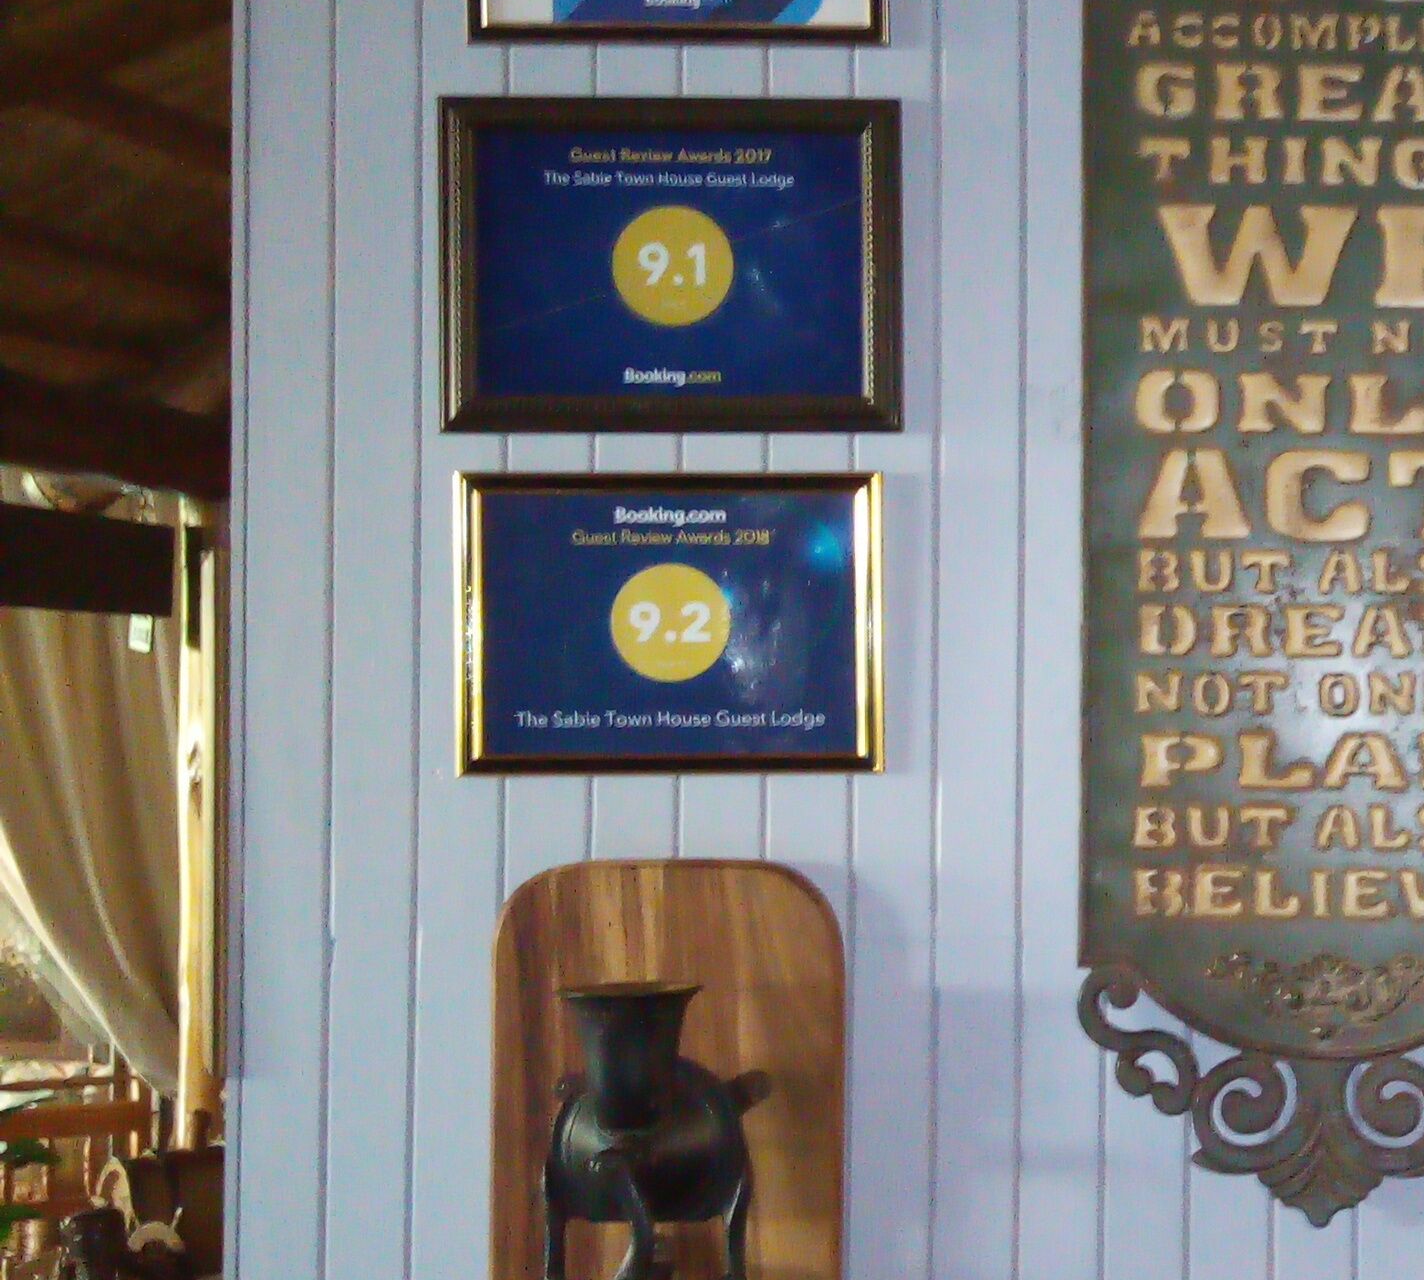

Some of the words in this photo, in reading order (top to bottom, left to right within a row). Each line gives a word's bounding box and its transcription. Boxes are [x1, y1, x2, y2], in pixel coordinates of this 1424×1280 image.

[569, 145, 617, 164] Guest
[619, 146, 673, 164] Review
[675, 147, 732, 164] Awards
[734, 147, 773, 164] 2017
[543, 168, 571, 186] The
[572, 169, 613, 187] Sabie
[615, 170, 655, 187] Town
[657, 170, 704, 188] House
[705, 170, 748, 188] Guest
[750, 170, 796, 191] Lodge
[636, 239, 709, 287] 9.1
[1140, 316, 1339, 355] MUST
[623, 367, 723, 388] Booking.com
[613, 505, 728, 527] Booking.com
[570, 528, 617, 546] Guest
[620, 528, 672, 546] Review
[675, 528, 732, 546] Awards
[1137, 548, 1293, 594] BUT
[627, 600, 712, 645] 9.2
[1135, 669, 1291, 717] NOT
[514, 709, 549, 729] The
[551, 709, 602, 729] Sabie
[604, 709, 653, 728] Town
[656, 710, 712, 729] House
[714, 709, 767, 729] Guest
[770, 708, 826, 732] Lodge
[1133, 806, 1293, 852] BUT
